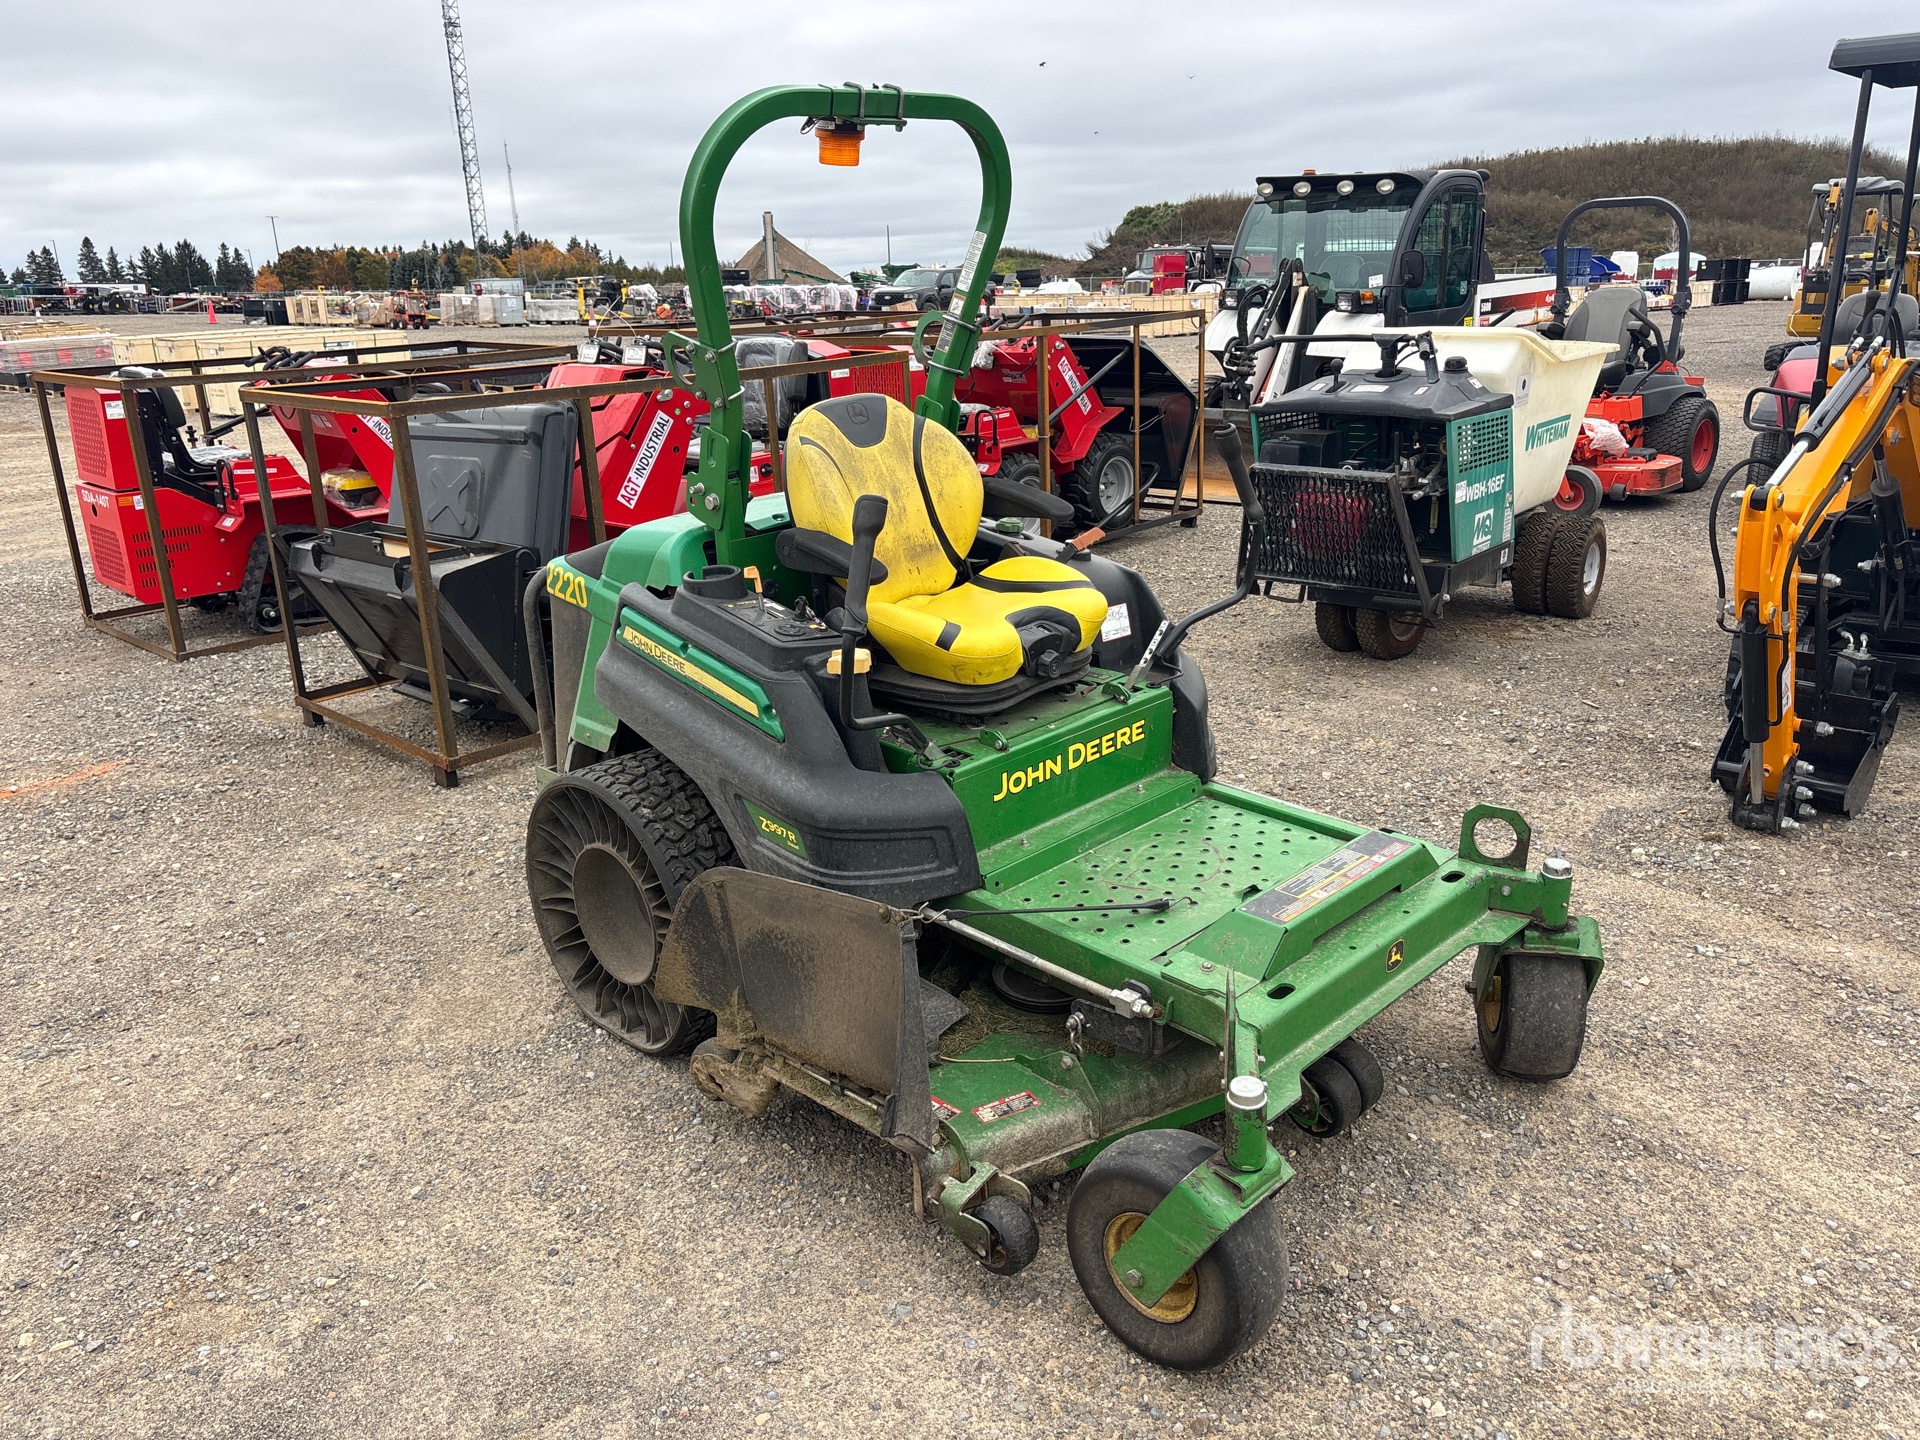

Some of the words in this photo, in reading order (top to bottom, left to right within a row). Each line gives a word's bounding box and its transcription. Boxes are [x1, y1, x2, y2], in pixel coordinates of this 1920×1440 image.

[1525, 413, 1571, 452] WHITEMAN
[1466, 473, 1505, 503] WBH-16EF
[546, 562, 588, 608] 2220
[629, 632, 653, 655] JOHN
[654, 646, 686, 673] DEERE
[993, 754, 1062, 802] JOHN
[1068, 719, 1145, 771] DEERE
